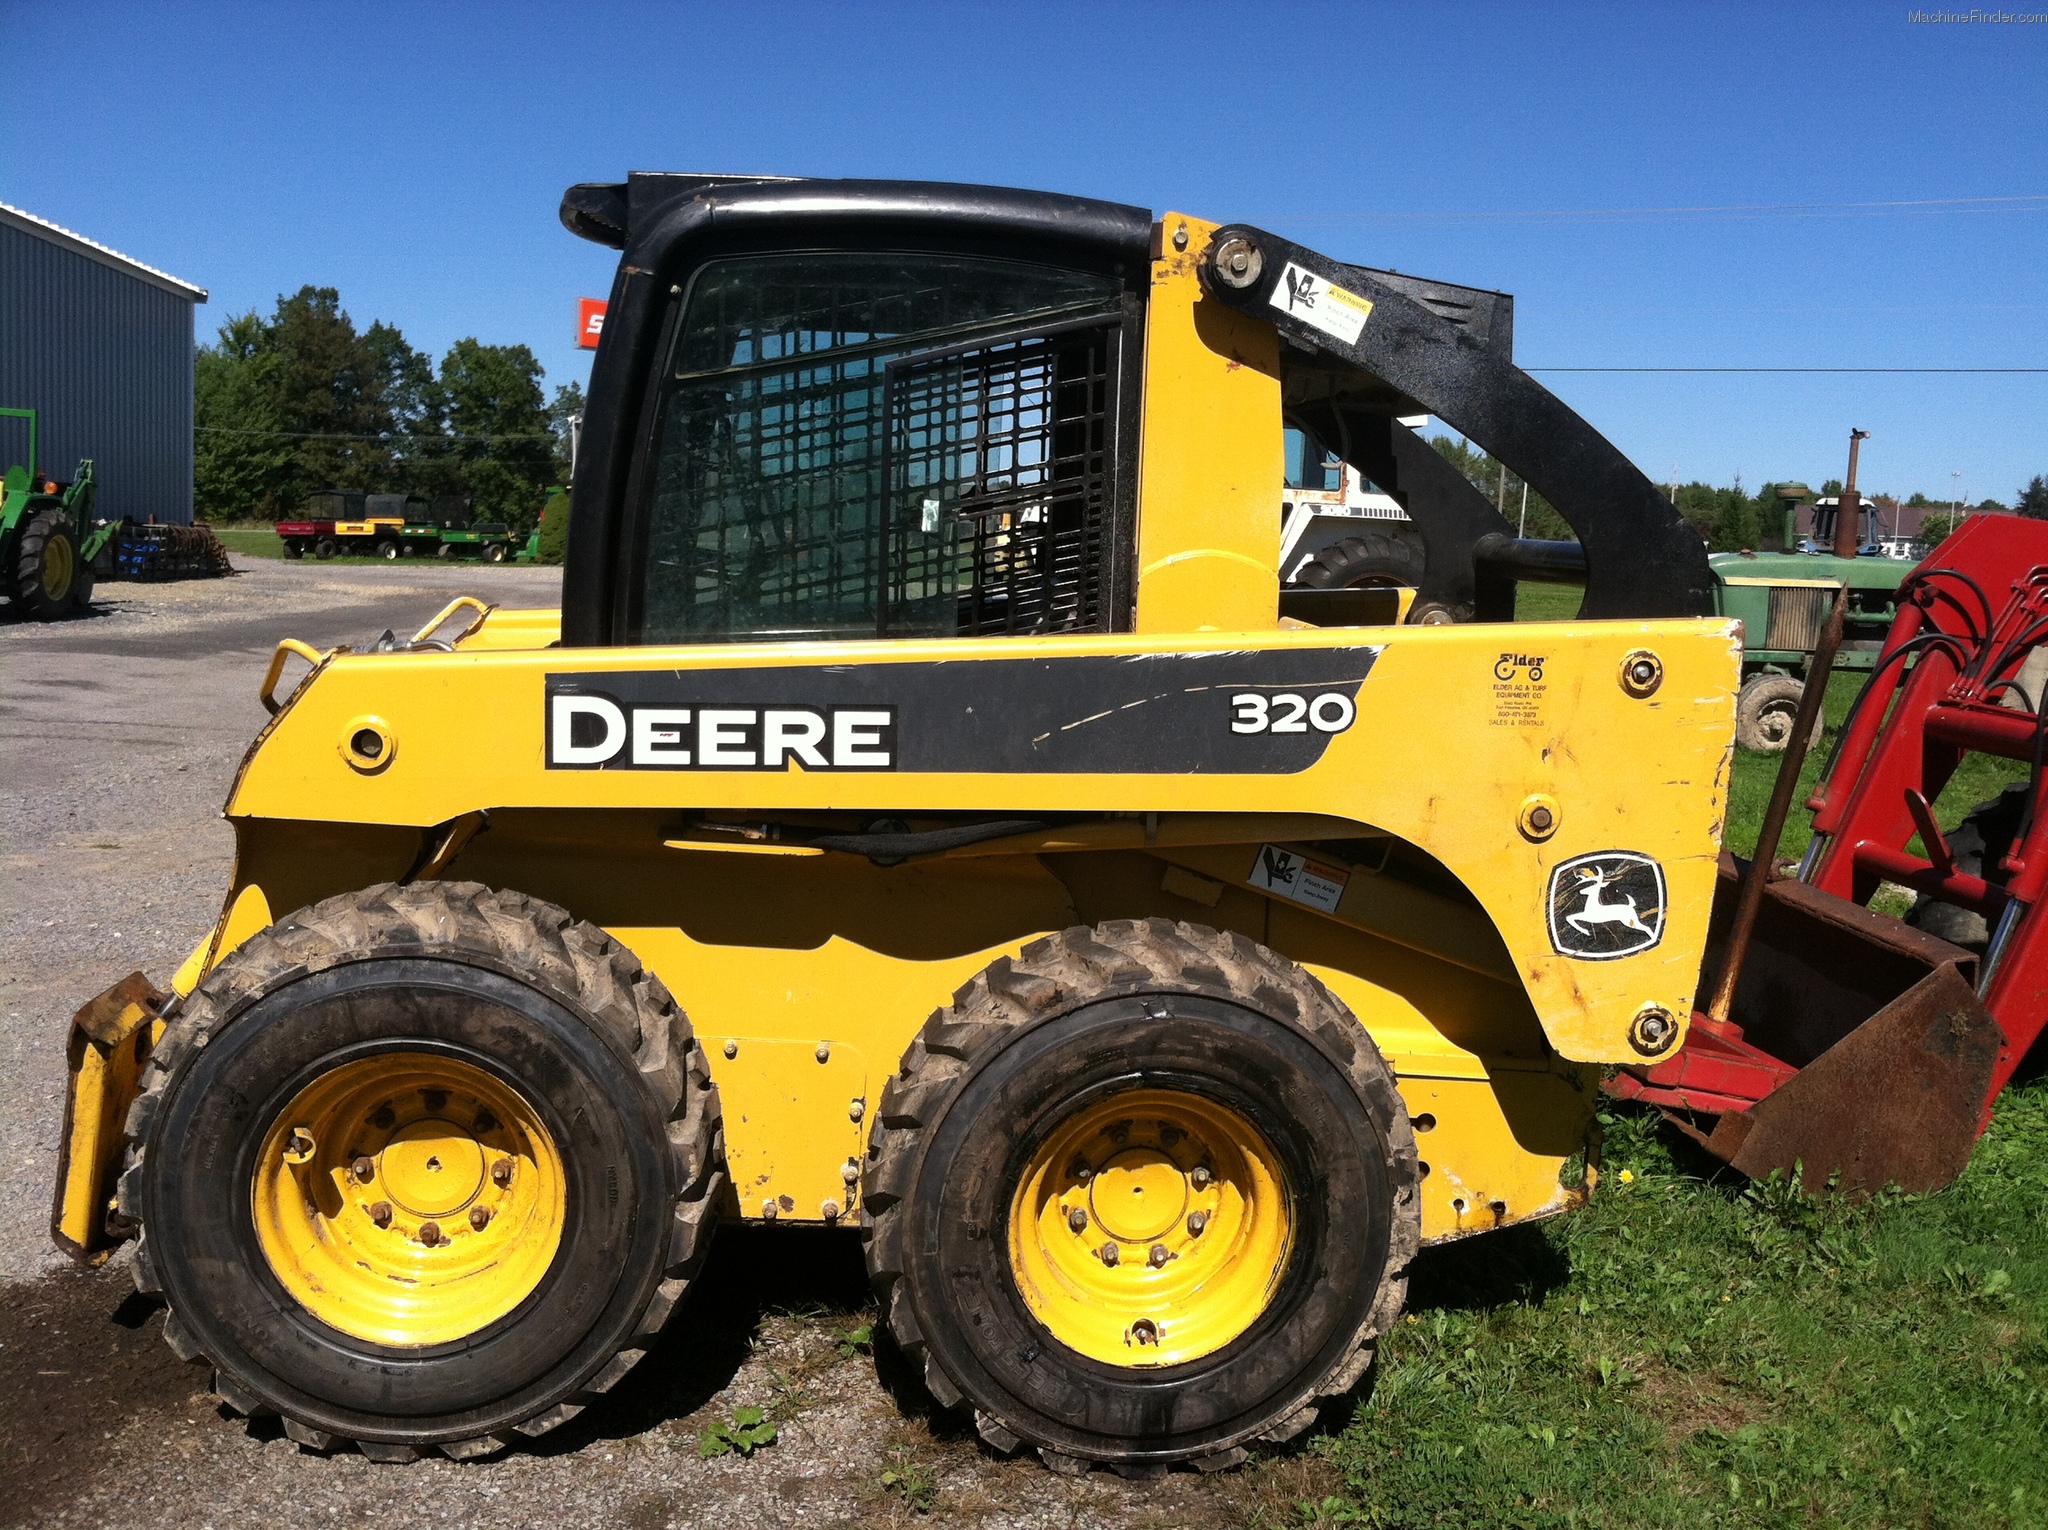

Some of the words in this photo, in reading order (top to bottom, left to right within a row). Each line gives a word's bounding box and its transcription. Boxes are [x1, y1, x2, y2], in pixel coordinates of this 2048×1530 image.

[1336, 292, 1367, 312] WARNING
[1494, 653, 1545, 681] Elder
[1532, 684, 1548, 692] TURF
[1231, 693, 1354, 733] 320
[1518, 719, 1545, 727] RENTALS
[552, 695, 891, 766] DEERE
[1304, 878, 1321, 888] Pinch
[1321, 885, 1336, 894] Area
